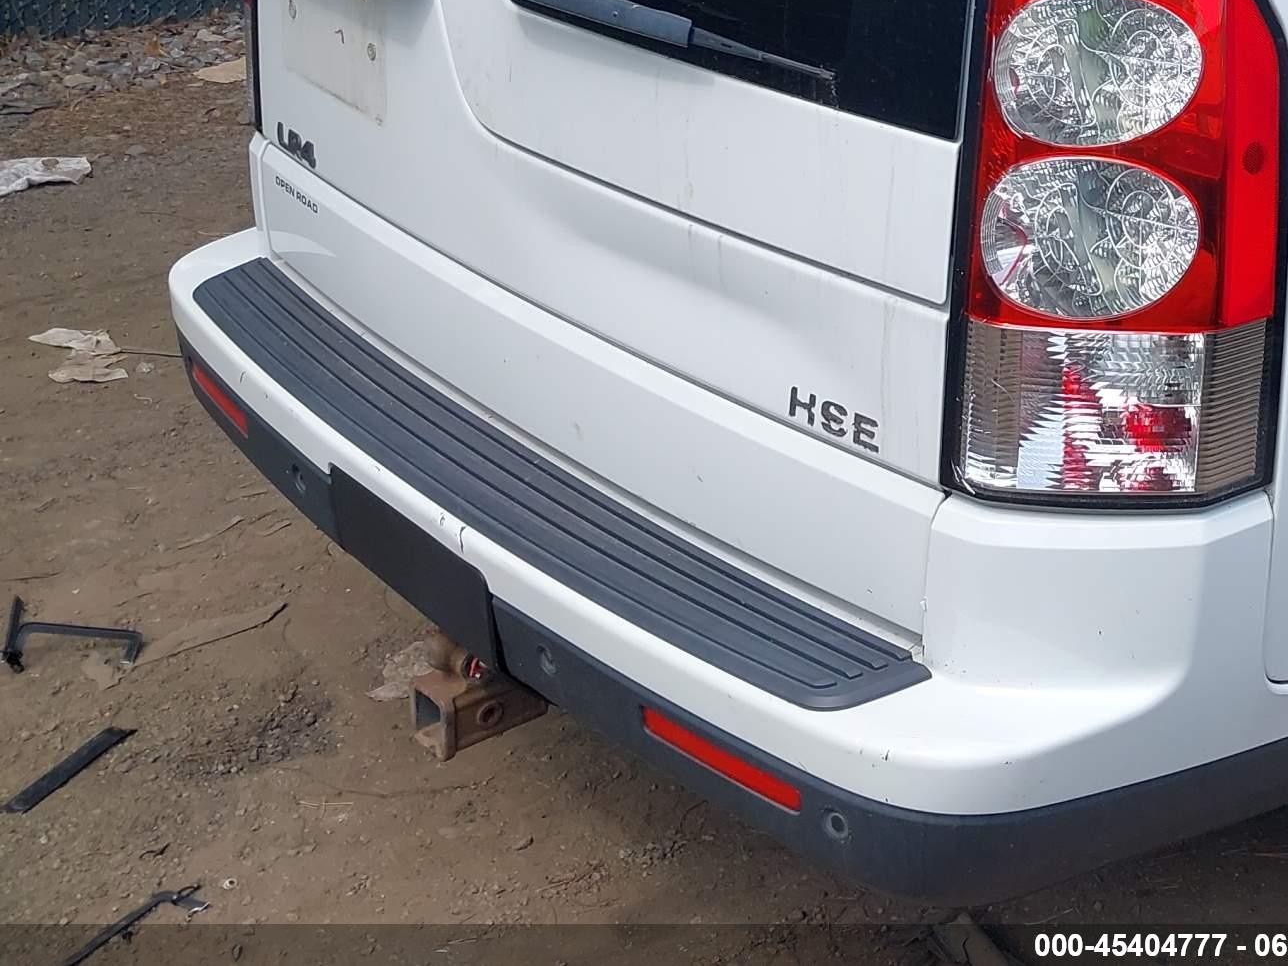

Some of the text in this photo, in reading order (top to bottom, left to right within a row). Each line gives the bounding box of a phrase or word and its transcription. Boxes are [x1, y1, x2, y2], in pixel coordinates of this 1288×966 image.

[275, 175, 318, 214] OPEN ROAD
[789, 386, 879, 454] HSE
